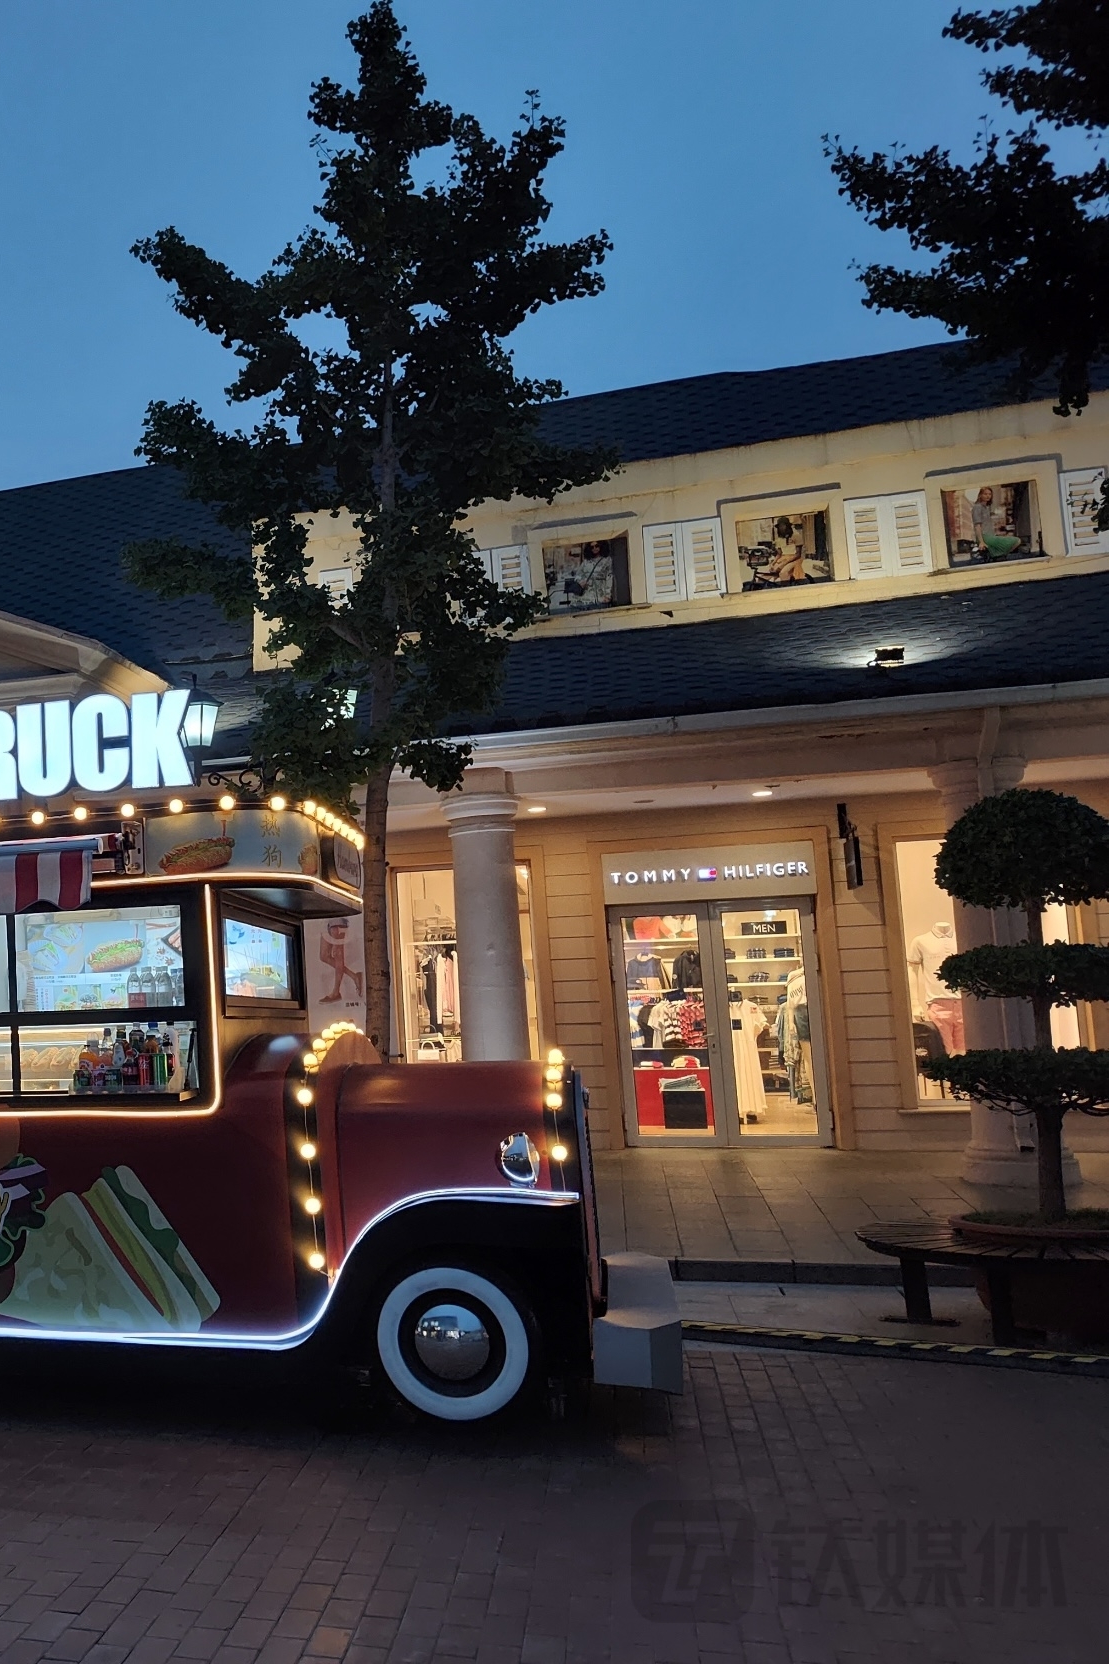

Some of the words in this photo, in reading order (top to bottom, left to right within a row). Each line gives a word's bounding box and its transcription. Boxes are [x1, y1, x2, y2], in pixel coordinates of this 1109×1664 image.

[260, 814, 282, 868] 热狗
[611, 868, 691, 884] TOMMY
[724, 861, 809, 879] HILFIGER
[751, 923, 777, 934] MEN
